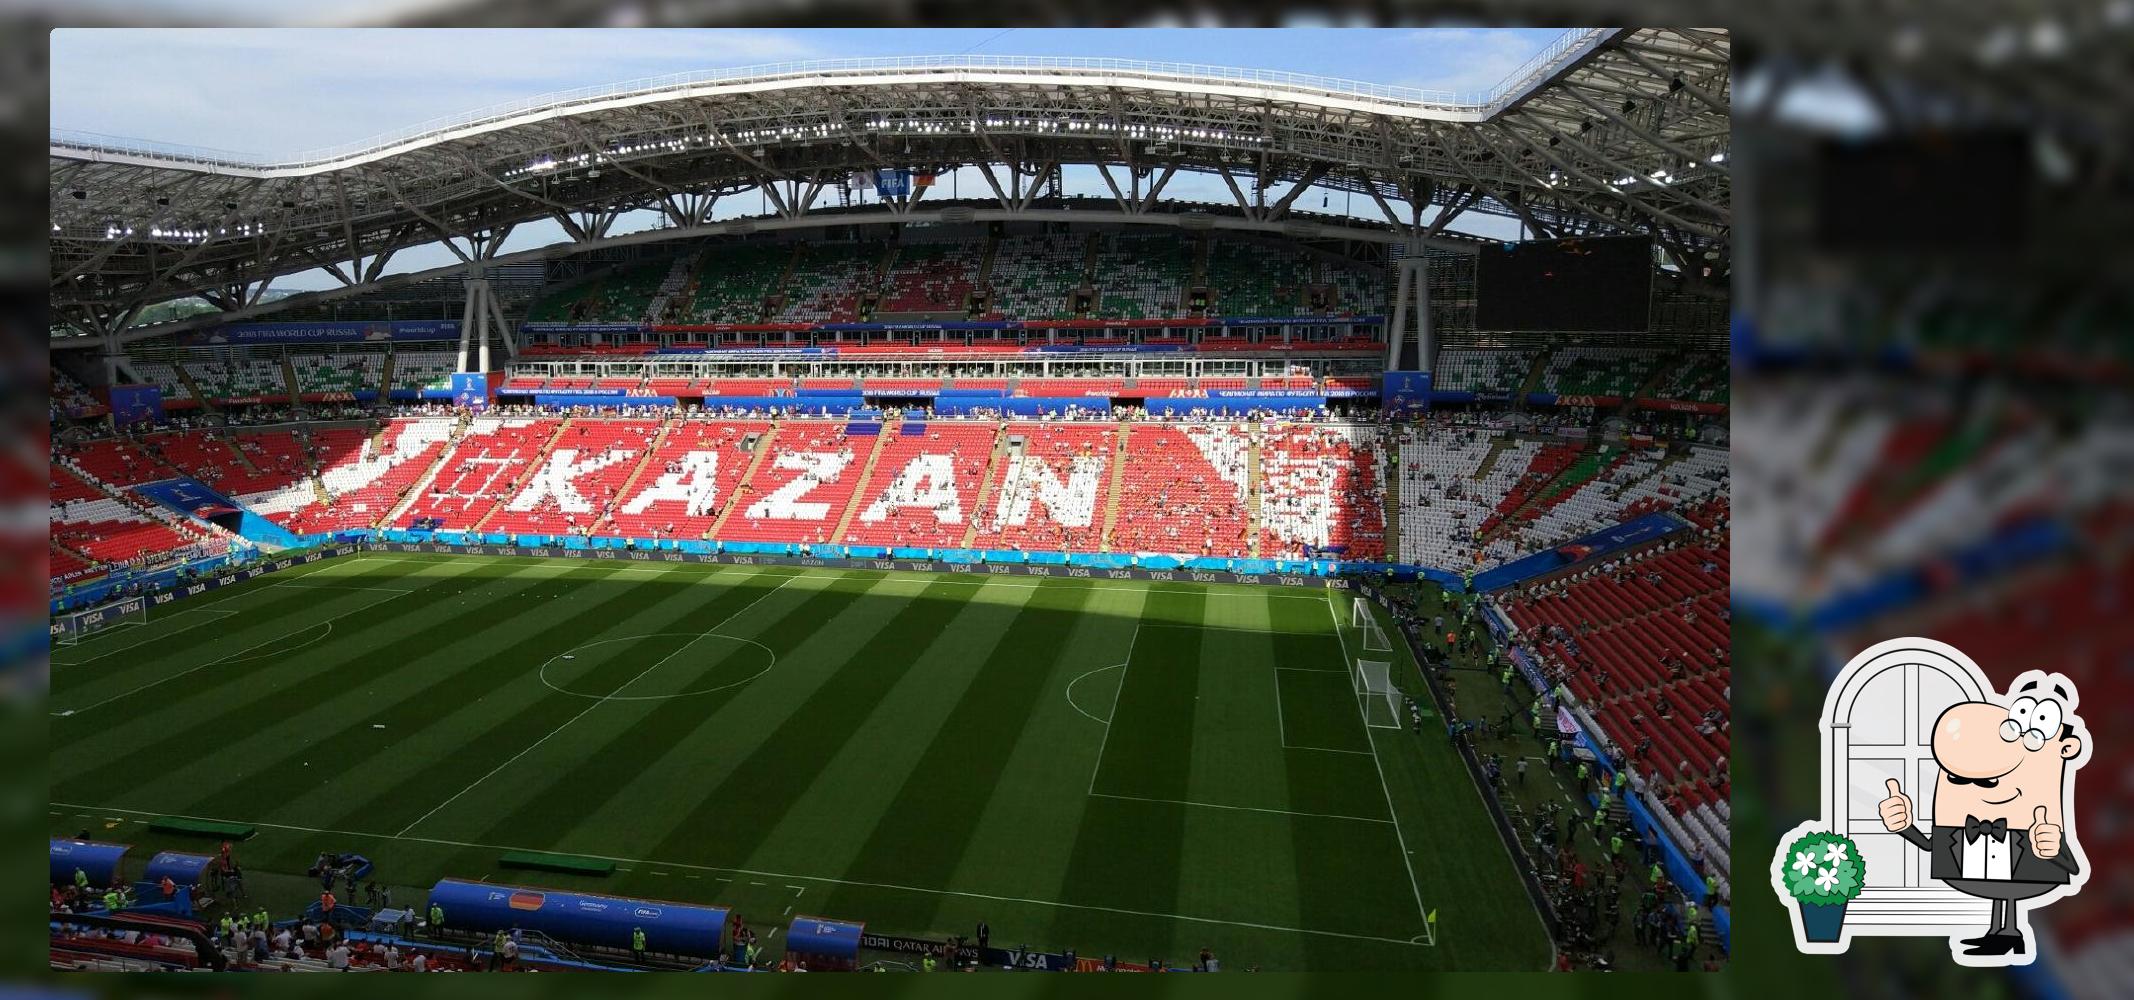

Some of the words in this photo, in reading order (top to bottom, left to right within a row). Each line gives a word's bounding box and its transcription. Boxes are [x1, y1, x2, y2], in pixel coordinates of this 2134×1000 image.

[881, 178, 904, 189] FIFA
[326, 328, 357, 336] RUSSIA
[336, 546, 354, 556] VISA
[402, 544, 421, 552] VISA
[434, 545, 452, 553] VISA
[466, 546, 484, 554] VISA
[498, 548, 516, 556] VISA
[530, 549, 549, 557] VISA
[305, 552, 322, 562] VISA
[564, 550, 582, 558] VISA
[596, 551, 615, 560] VISA
[630, 552, 650, 560] VISA
[664, 554, 684, 562] VISA
[698, 555, 718, 563] VISA
[276, 559, 292, 570] VISA
[733, 556, 753, 564] VISA
[873, 560, 895, 570] VISA
[248, 566, 264, 578] VISA
[912, 562, 932, 572] VISA
[950, 564, 972, 573] VISA
[987, 565, 1010, 574] VISA
[1027, 566, 1050, 576] VISA
[1067, 568, 1091, 578] VISA
[1108, 570, 1132, 579] VISA
[1150, 572, 1173, 580] VISA
[1191, 572, 1216, 582] VISA
[219, 574, 236, 586] VISA
[1235, 574, 1260, 584] VISA
[1278, 576, 1304, 586] VISA
[187, 583, 206, 595] VISA
[1324, 579, 1350, 590] VISA
[1360, 584, 1372, 598] VISA
[154, 592, 174, 604] VISA
[119, 602, 140, 614] VISA
[83, 612, 104, 625] VISA
[50, 622, 66, 634] ISA
[893, 940, 930, 954] QATAR
[931, 944, 979, 958] AIAYS
[1008, 951, 1048, 970] VSA
